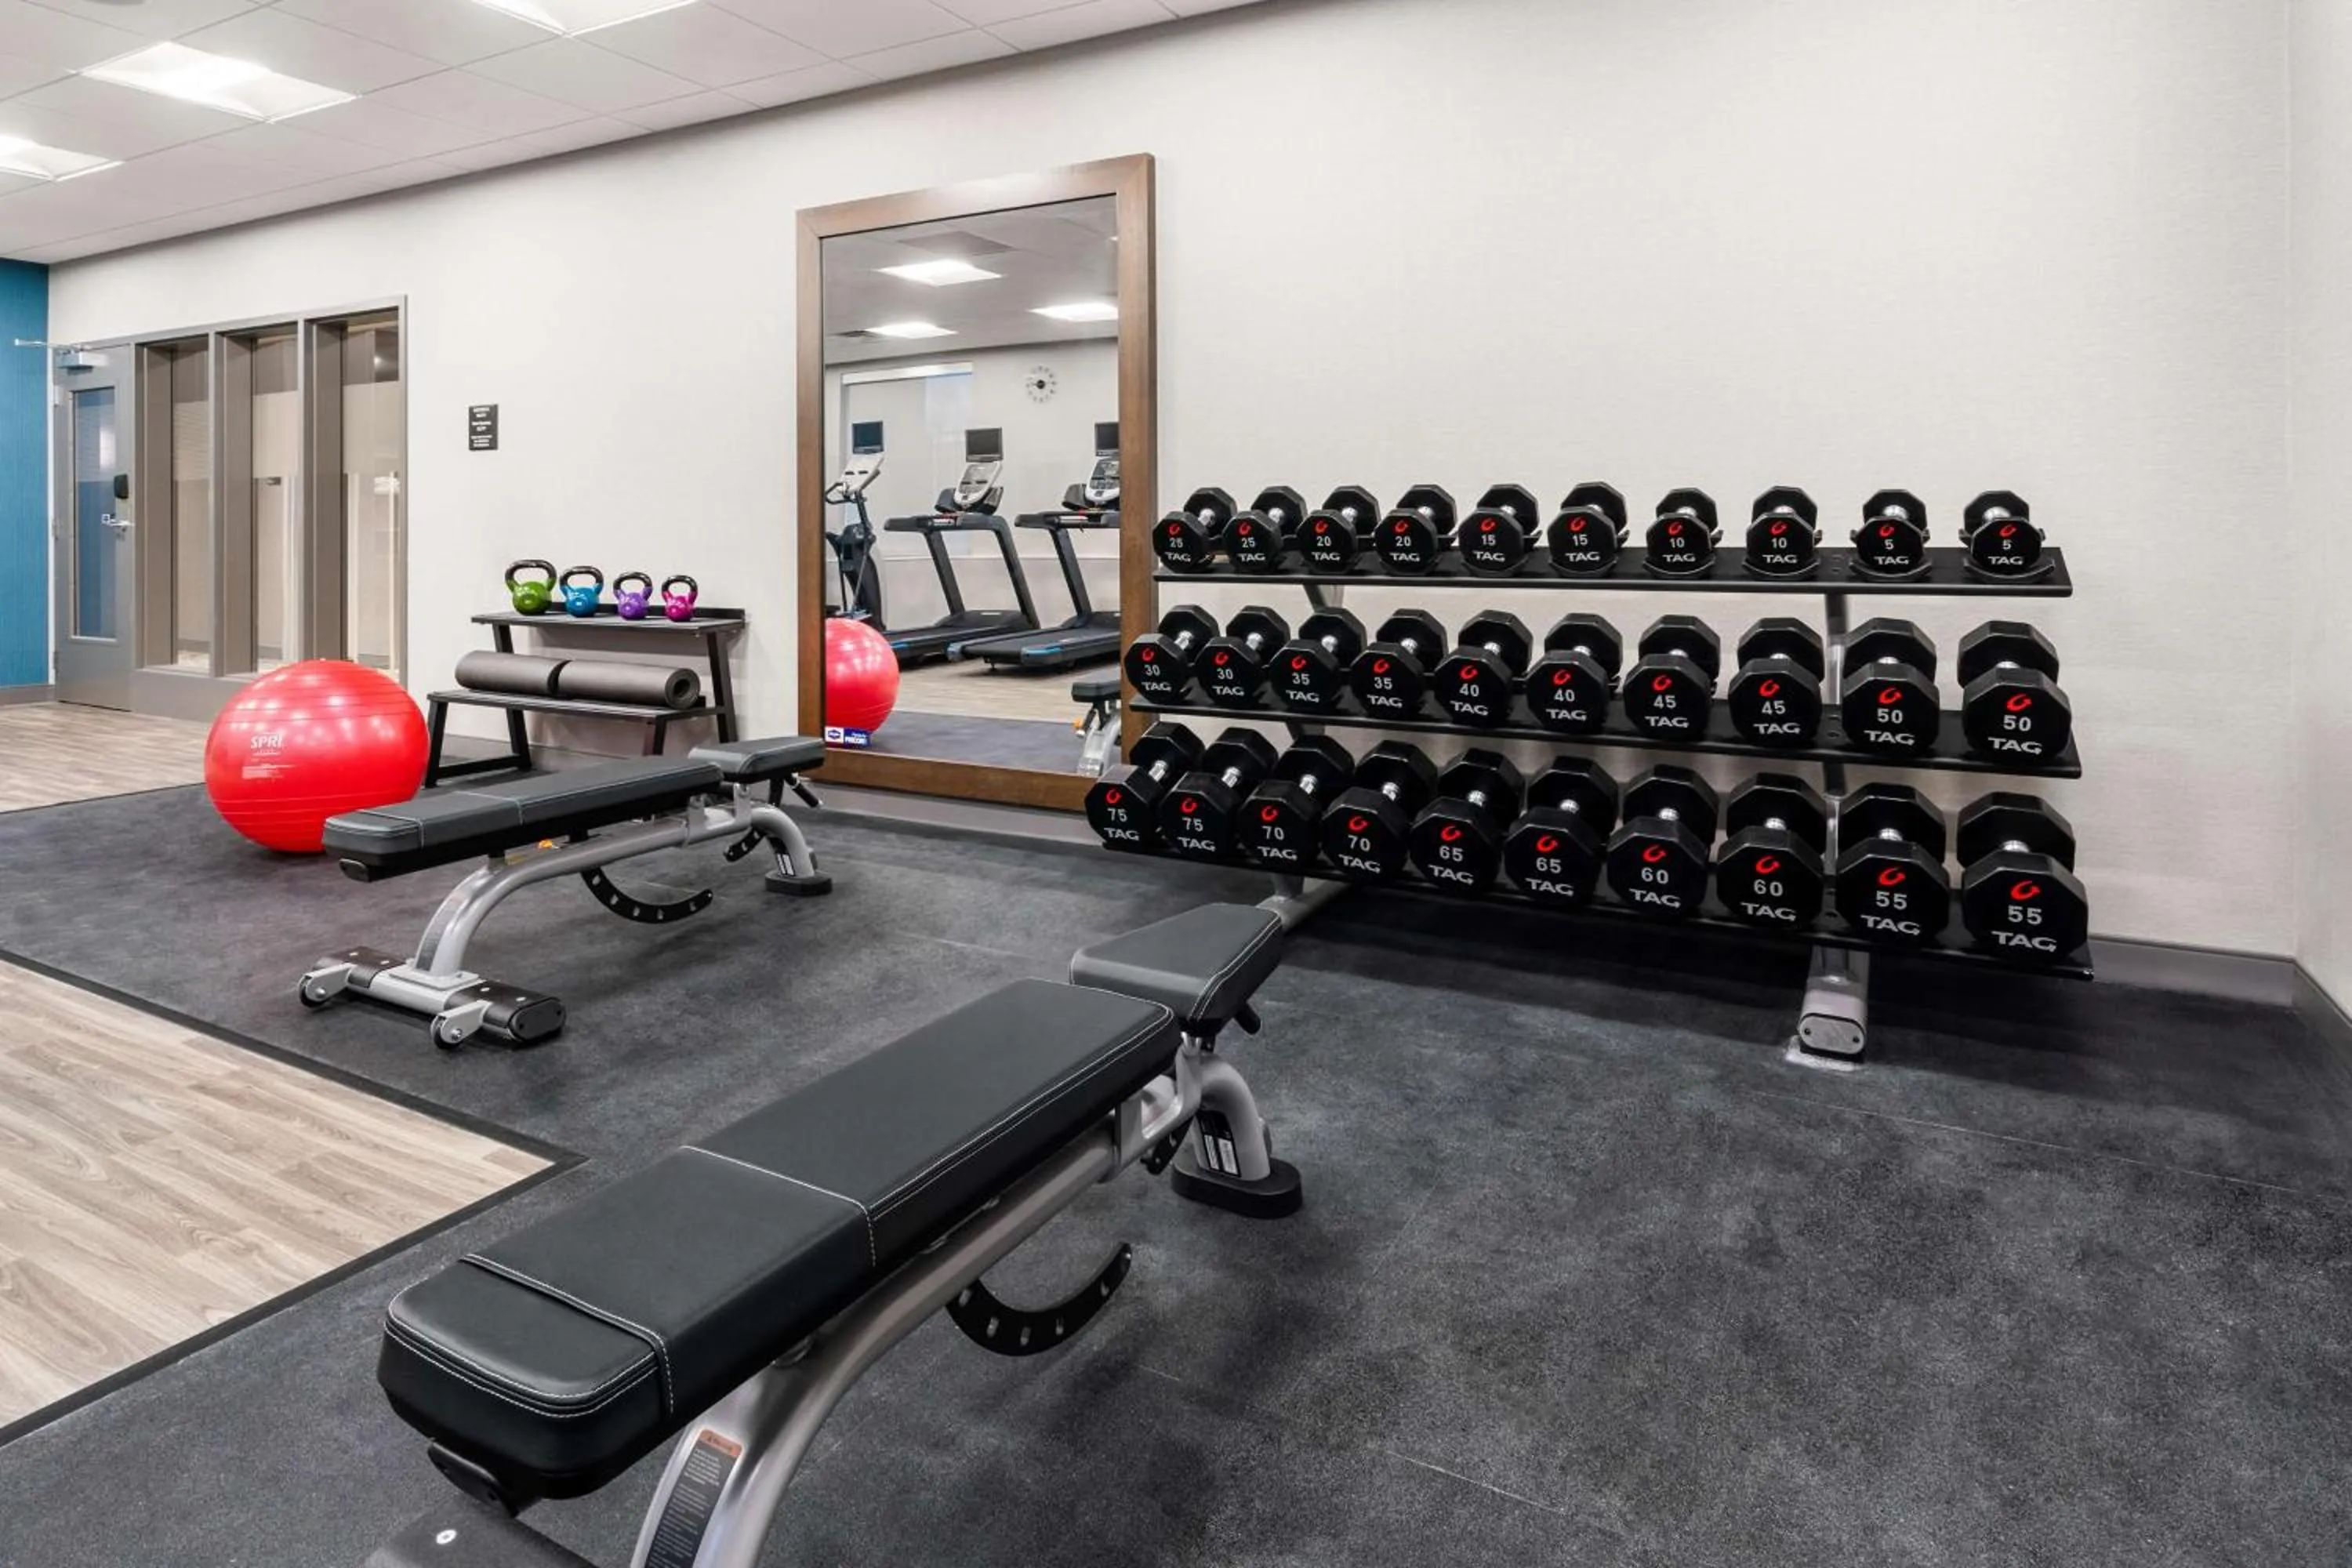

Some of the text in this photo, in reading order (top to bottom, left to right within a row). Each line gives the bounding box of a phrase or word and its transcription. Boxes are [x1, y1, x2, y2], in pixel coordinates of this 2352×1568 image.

[1170, 537, 1183, 548] 25
[1242, 537, 1255, 547] 25
[1317, 536, 1331, 546] 20
[1396, 536, 1411, 546] 20
[1482, 535, 1496, 546] 15
[1573, 534, 1588, 546] 15
[1670, 538, 1685, 548] 10
[1772, 538, 1787, 548] 10
[1885, 539, 1894, 550] 5
[2003, 539, 2011, 550] 5
[1165, 552, 1191, 562] TAG
[1312, 552, 1340, 561] TAG
[1390, 553, 1420, 561] TAG
[1474, 551, 1505, 561] TAG
[1566, 552, 1599, 561] TAG
[1663, 554, 1695, 562] TAG
[1875, 556, 1909, 564] TAG
[1145, 665, 1160, 676] 30
[1217, 668, 1233, 679] 30
[1292, 673, 1309, 685] 35
[1374, 677, 1392, 689] 35
[1142, 682, 1171, 691] TAG
[1213, 686, 1244, 695] TAG
[1460, 684, 1479, 696] 40
[1286, 690, 1319, 702] TAG
[1367, 695, 1402, 707] TAG
[1555, 689, 1574, 702] 40
[1450, 701, 1488, 715] TAG
[1653, 695, 1676, 709] 45
[1762, 700, 1785, 714] 45
[1546, 709, 1586, 720] TAG
[1878, 709, 1903, 724] 50
[1645, 717, 1689, 728] TAG
[1754, 723, 1800, 734] TAG
[2004, 715, 2031, 731] 50
[1864, 731, 1915, 745] TAG
[1988, 737, 2042, 754] TAG
[1108, 808, 1127, 822] 75
[1182, 817, 1203, 831] 75
[1104, 828, 1139, 841] TAG
[1262, 826, 1284, 840] 70
[1178, 837, 1215, 851] TAG
[1348, 835, 1370, 851] 70
[1258, 847, 1297, 860] TAG
[1439, 846, 1463, 862] 65
[1339, 855, 1380, 873] TAG
[1537, 857, 1561, 873] 65
[1428, 865, 1473, 884] TAG
[1642, 867, 1668, 884] 60
[1526, 878, 1573, 896] TAG
[1754, 879, 1783, 896] 60
[1630, 889, 1680, 908] TAG
[1876, 891, 1907, 909] 55
[1741, 902, 1795, 921] TAG
[2009, 906, 2042, 924] 55
[1861, 915, 1920, 935] TAG
[1991, 931, 2056, 952] TAG
